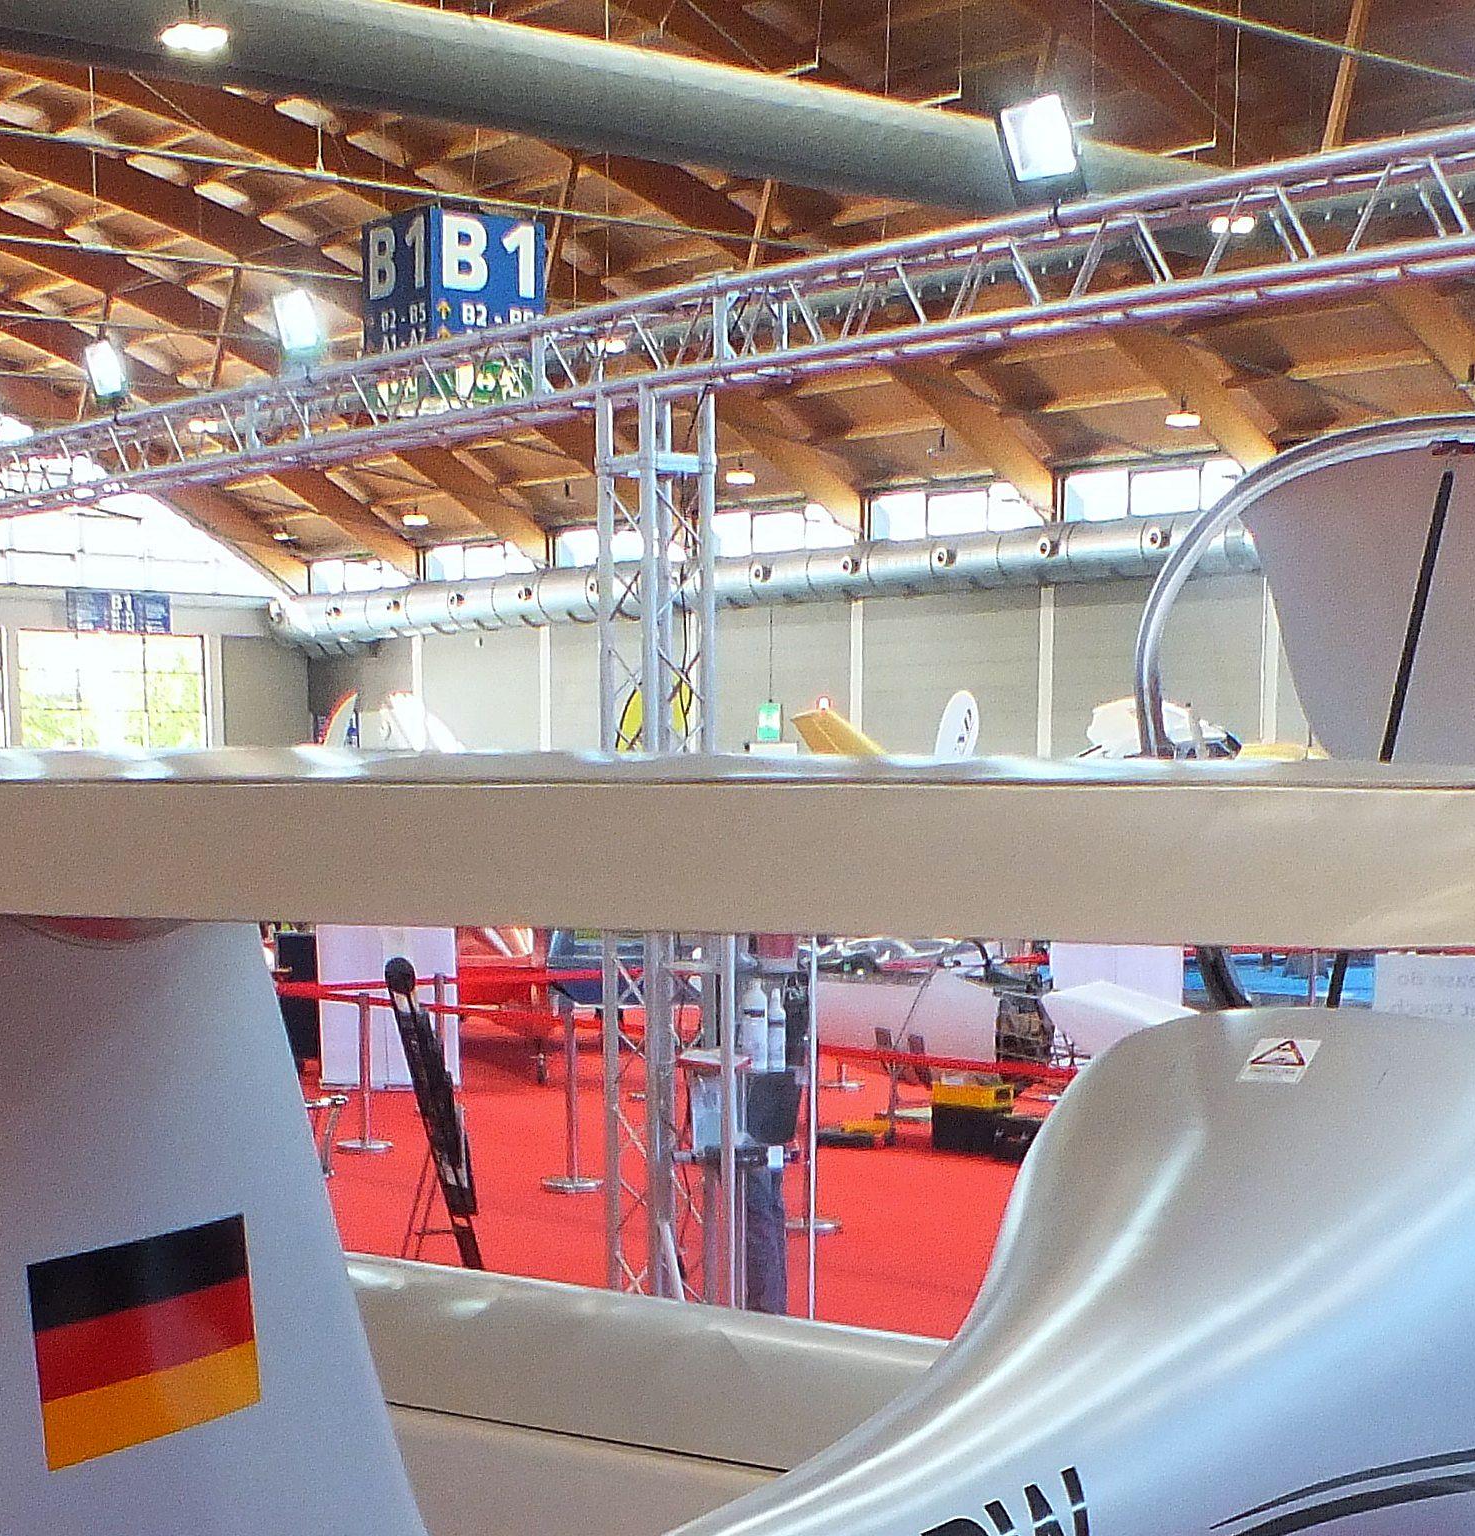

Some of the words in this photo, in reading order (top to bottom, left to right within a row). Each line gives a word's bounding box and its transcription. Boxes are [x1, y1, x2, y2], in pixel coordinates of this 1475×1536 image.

[369, 214, 425, 300] B1
[442, 212, 535, 300] B1
[461, 301, 488, 328] B2
